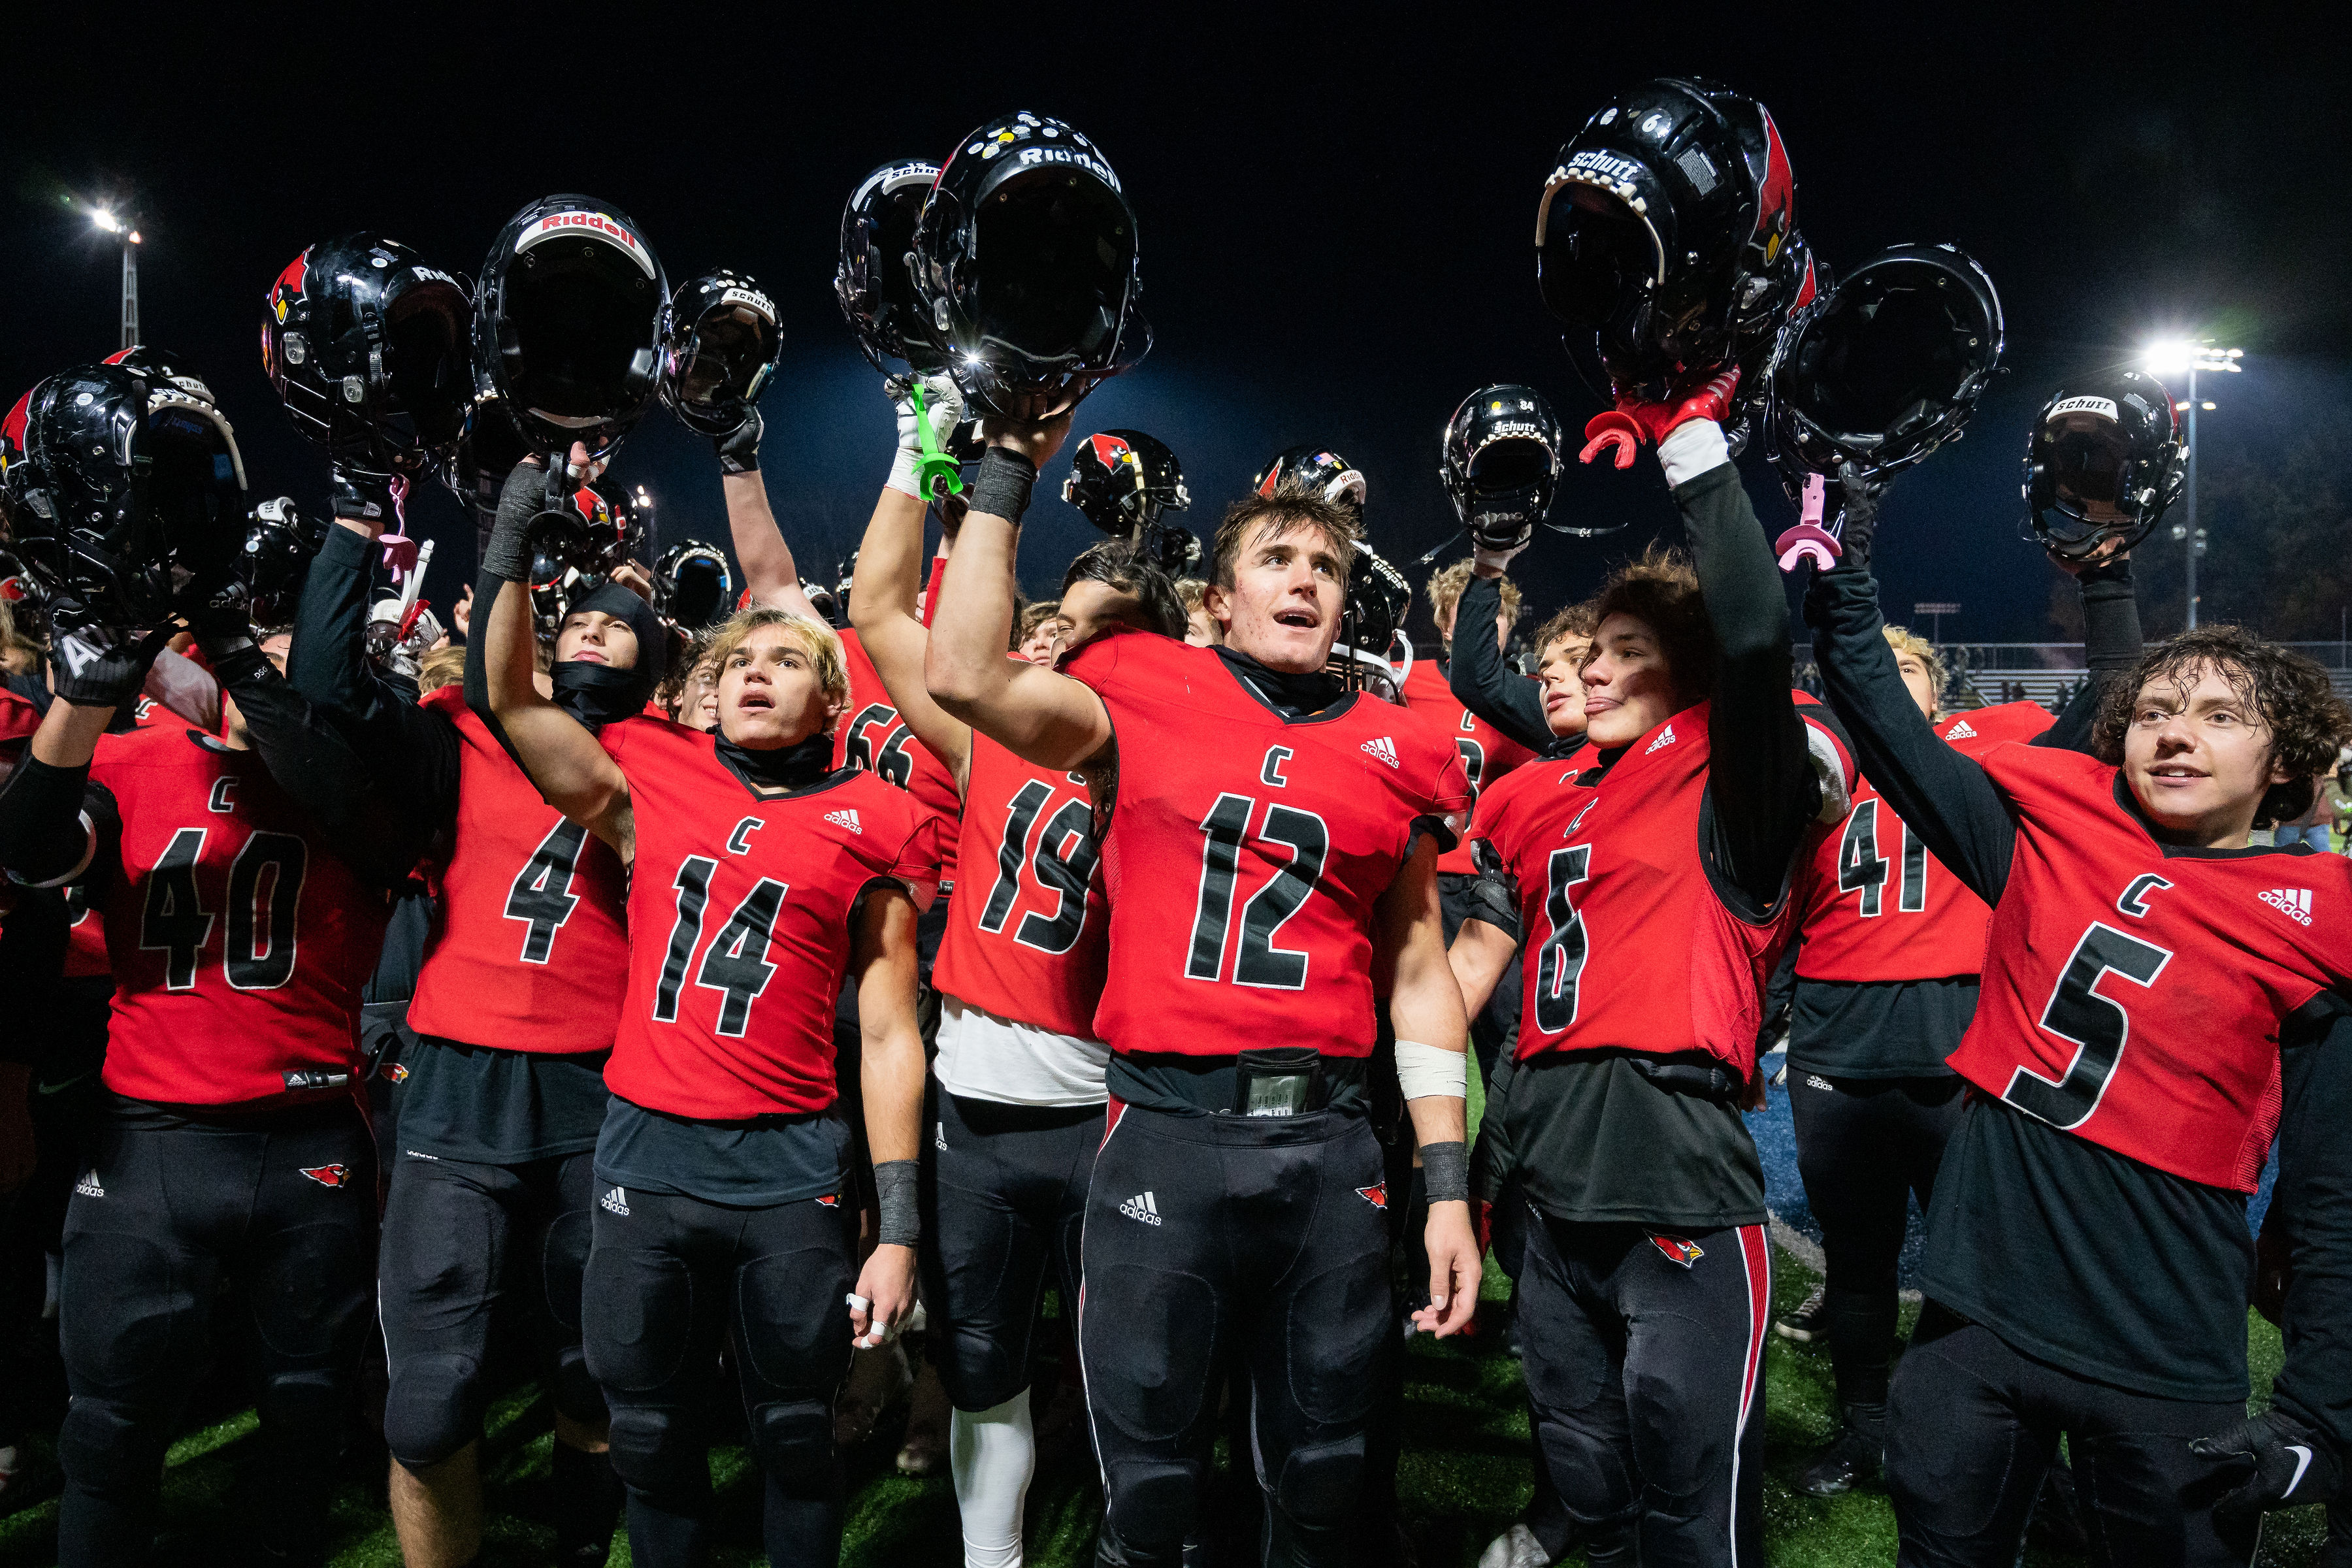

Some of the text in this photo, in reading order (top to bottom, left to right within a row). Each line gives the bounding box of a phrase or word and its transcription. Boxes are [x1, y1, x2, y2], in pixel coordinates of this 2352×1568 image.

[1642, 114, 1661, 132] 6
[1019, 148, 1122, 193] Riddell
[1568, 148, 1638, 182] schutt
[542, 214, 636, 250] Riddell
[1520, 400, 1534, 412] 84
[2057, 399, 2112, 412] schutt
[1494, 421, 1536, 433] schutt
[253, 665, 269, 679] DSG
[1644, 735, 1676, 756] adidas
[1945, 730, 1978, 741] adidas
[1260, 744, 1294, 788] C
[1360, 743, 1400, 769] adidas
[207, 776, 240, 813] C
[726, 816, 765, 857] C
[824, 813, 862, 835] adidas
[978, 778, 1100, 955] 19
[1838, 797, 1928, 918] 41
[502, 815, 588, 965] 4
[1184, 792, 1330, 990] 12
[2117, 872, 2174, 919] C
[2257, 890, 2312, 926] adidas
[139, 828, 308, 990] 40
[653, 853, 789, 1039] 14
[1535, 843, 1592, 1036] 6
[2001, 921, 2174, 1130] 5
[1806, 1079, 1833, 1091] adidas
[601, 1198, 630, 1216] adidas
[1119, 1203, 1162, 1226] adidas
